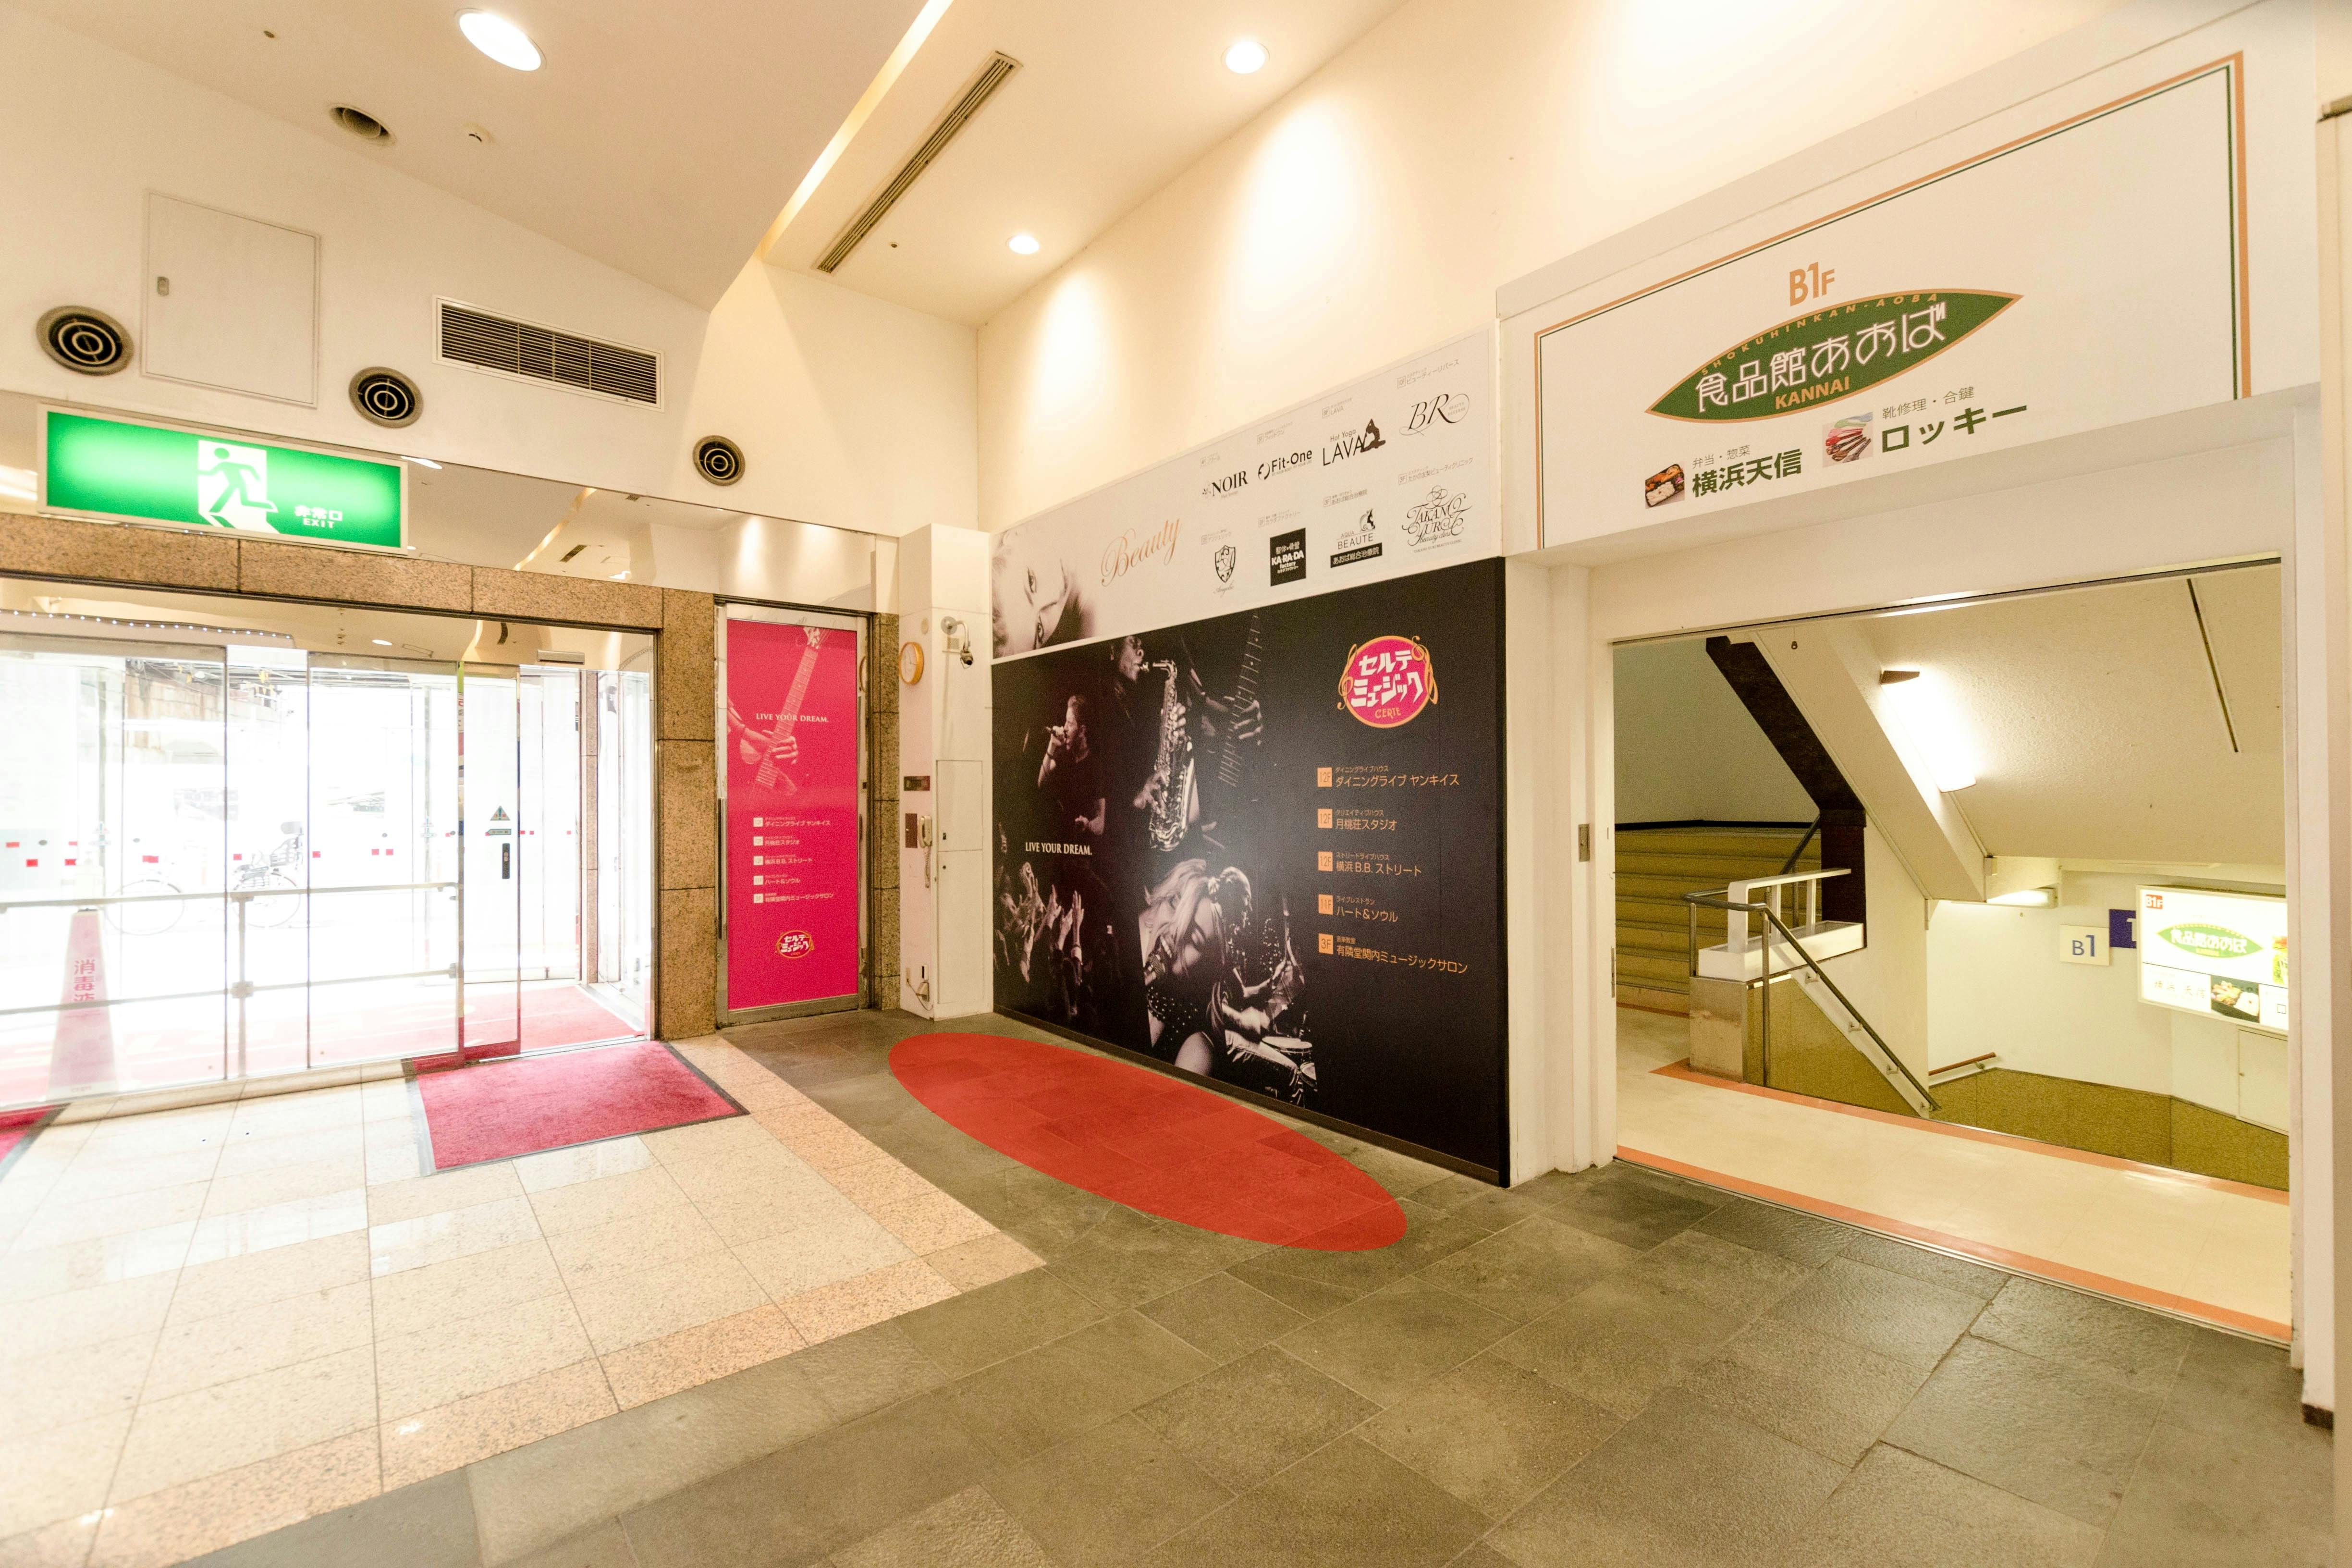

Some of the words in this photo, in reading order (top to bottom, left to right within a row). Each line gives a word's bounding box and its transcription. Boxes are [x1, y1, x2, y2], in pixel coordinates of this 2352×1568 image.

[1789, 262, 1835, 306] B1F
[1702, 293, 1938, 375] SHOKUHINKAN-AOBA
[1696, 300, 1947, 413] 食品館あおば
[1775, 376, 1850, 410] KANNAI
[1330, 406, 1344, 416] LAVA
[1882, 385, 1974, 420] 靴修理・合鍵
[1342, 429, 1356, 438] Yoga
[1881, 404, 2028, 453] ロッキー
[1323, 434, 1364, 466] LAVA
[1692, 444, 1751, 469] 弁当・惣菜
[1272, 450, 1313, 472] Fit-One
[1692, 449, 1802, 498] 横浜天信
[1212, 471, 1248, 496] NOIR
[303, 518, 335, 528] EXIT
[1341, 530, 1355, 539] AQUA
[1101, 518, 1180, 587] Beauty
[1333, 546, 1379, 564] あおば総合治療院
[1359, 649, 1412, 676] セルテ
[1350, 672, 1423, 707] ミュージック
[1374, 707, 1401, 719] CERTE
[1319, 772, 1331, 783] 12F
[1336, 774, 1407, 787] ダイニングライブ
[1410, 773, 1459, 786] ヤンキイス
[1320, 813, 1331, 824] 12F
[1025, 842, 1040, 852] LIVE
[1041, 843, 1062, 854] YOUR
[1064, 844, 1092, 855] DREAM.
[1336, 861, 1353, 873] 横浜
[1376, 863, 1422, 877] ストリート
[1321, 898, 1332, 909] 11F
[2145, 895, 2163, 909] B1F
[780, 941, 809, 953] ミュージック
[784, 934, 806, 943] セルテ
[1321, 938, 1331, 949] 3F
[2072, 934, 2095, 957] B1
